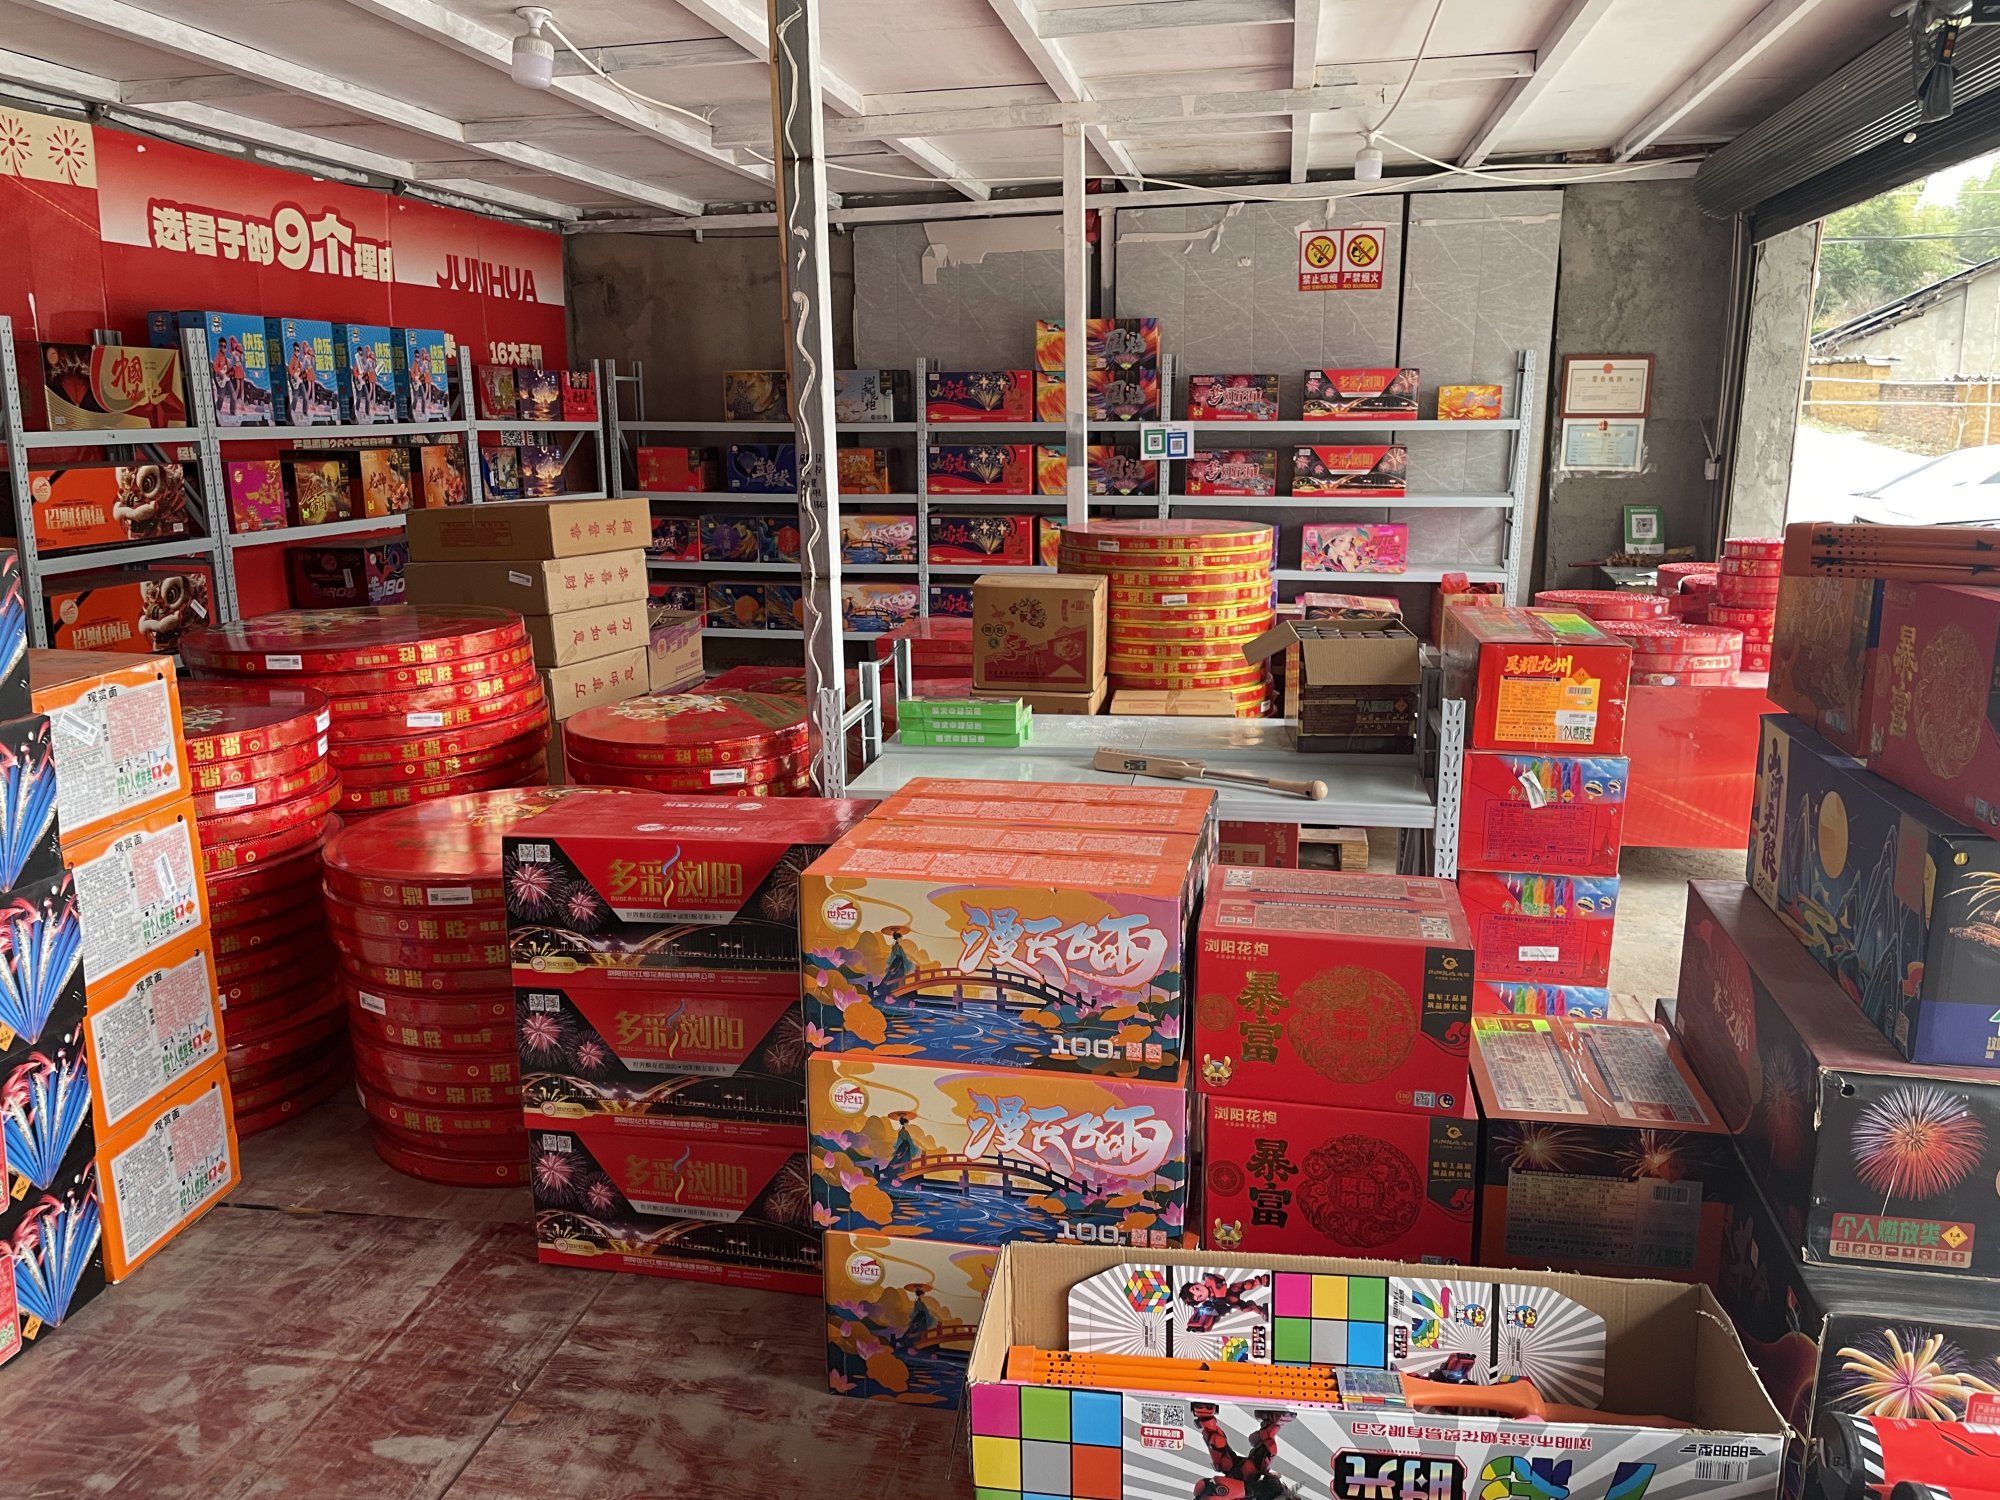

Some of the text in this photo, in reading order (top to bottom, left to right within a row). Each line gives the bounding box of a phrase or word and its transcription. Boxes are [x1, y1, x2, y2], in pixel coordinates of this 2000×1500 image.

[152, 206, 393, 283] 选君子的9个理由
[437, 254, 538, 302] JUNHUA
[1302, 273, 1338, 285] 禁止吸烟
[1343, 272, 1379, 283] 严禁烟火
[416, 666, 453, 685] 鼎胜
[1504, 654, 1574, 678] 星耀九州
[478, 678, 505, 698] 鼎胜
[608, 853, 744, 899] 多彩浏阳
[1204, 938, 1270, 957] 浏阳花炮
[614, 1009, 744, 1050] 多彩浏阳
[1237, 970, 1290, 1065] 暴富
[1214, 1106, 1277, 1125] 浏阳花炮
[623, 1153, 748, 1199] 多彩浏阳
[1246, 1138, 1298, 1229] 暴富
[1837, 1215, 1942, 1248] 个人燃放类
[1142, 1437, 1182, 1450] 12支/箱
